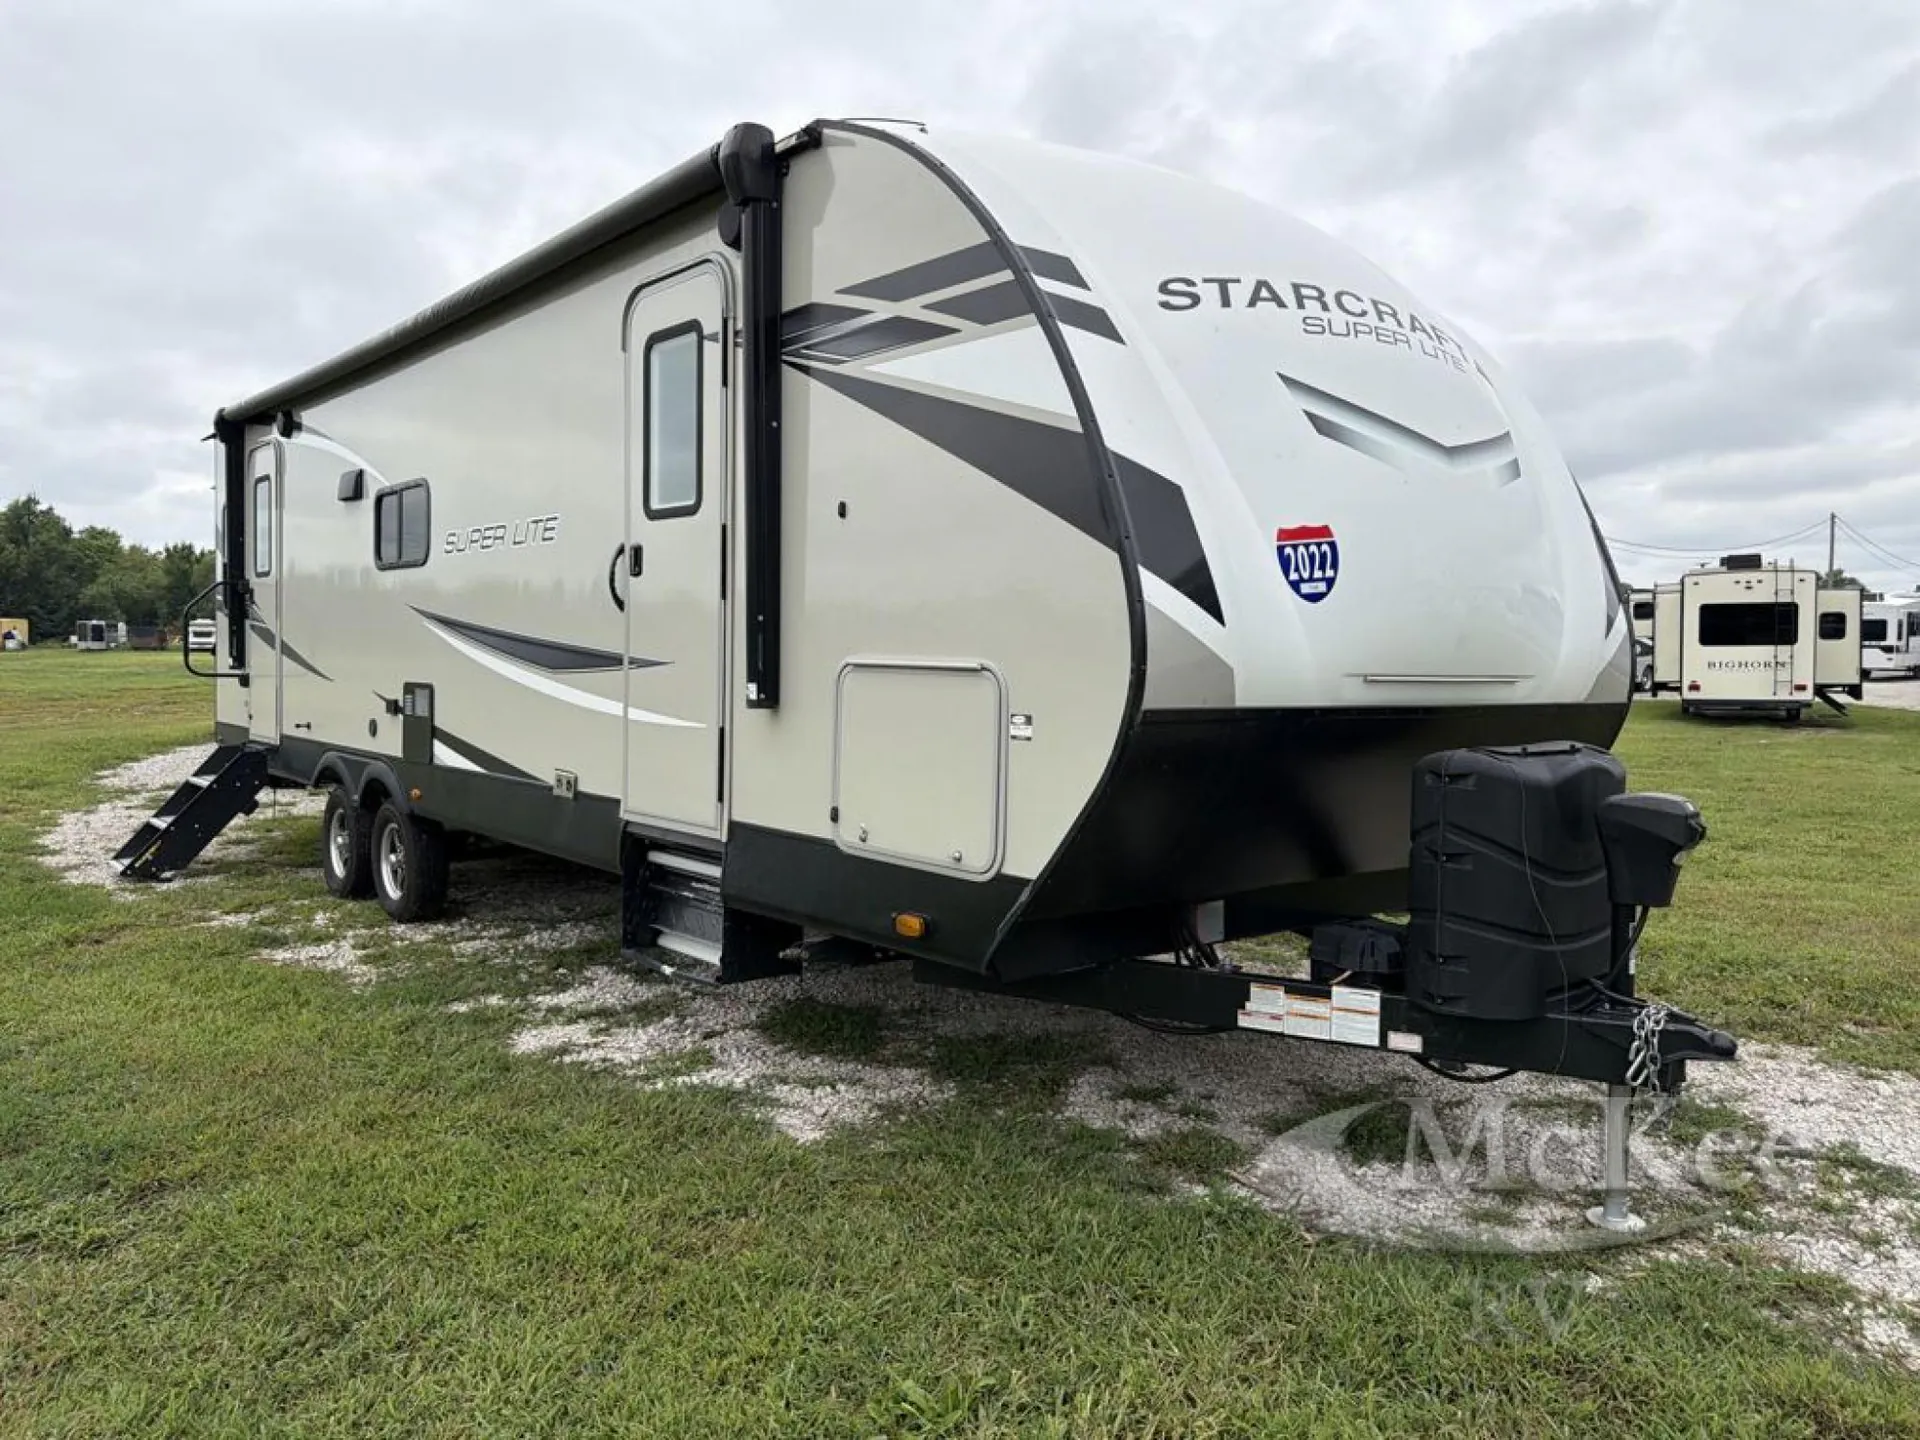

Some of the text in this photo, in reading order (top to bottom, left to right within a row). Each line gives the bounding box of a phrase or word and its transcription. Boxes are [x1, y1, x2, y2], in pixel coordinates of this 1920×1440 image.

[1302, 316, 1467, 374] SUPER LITE
[444, 515, 559, 554] SUPER LITE
[1284, 543, 1335, 580] 2022
[1707, 660, 1786, 669] BIGHORN
